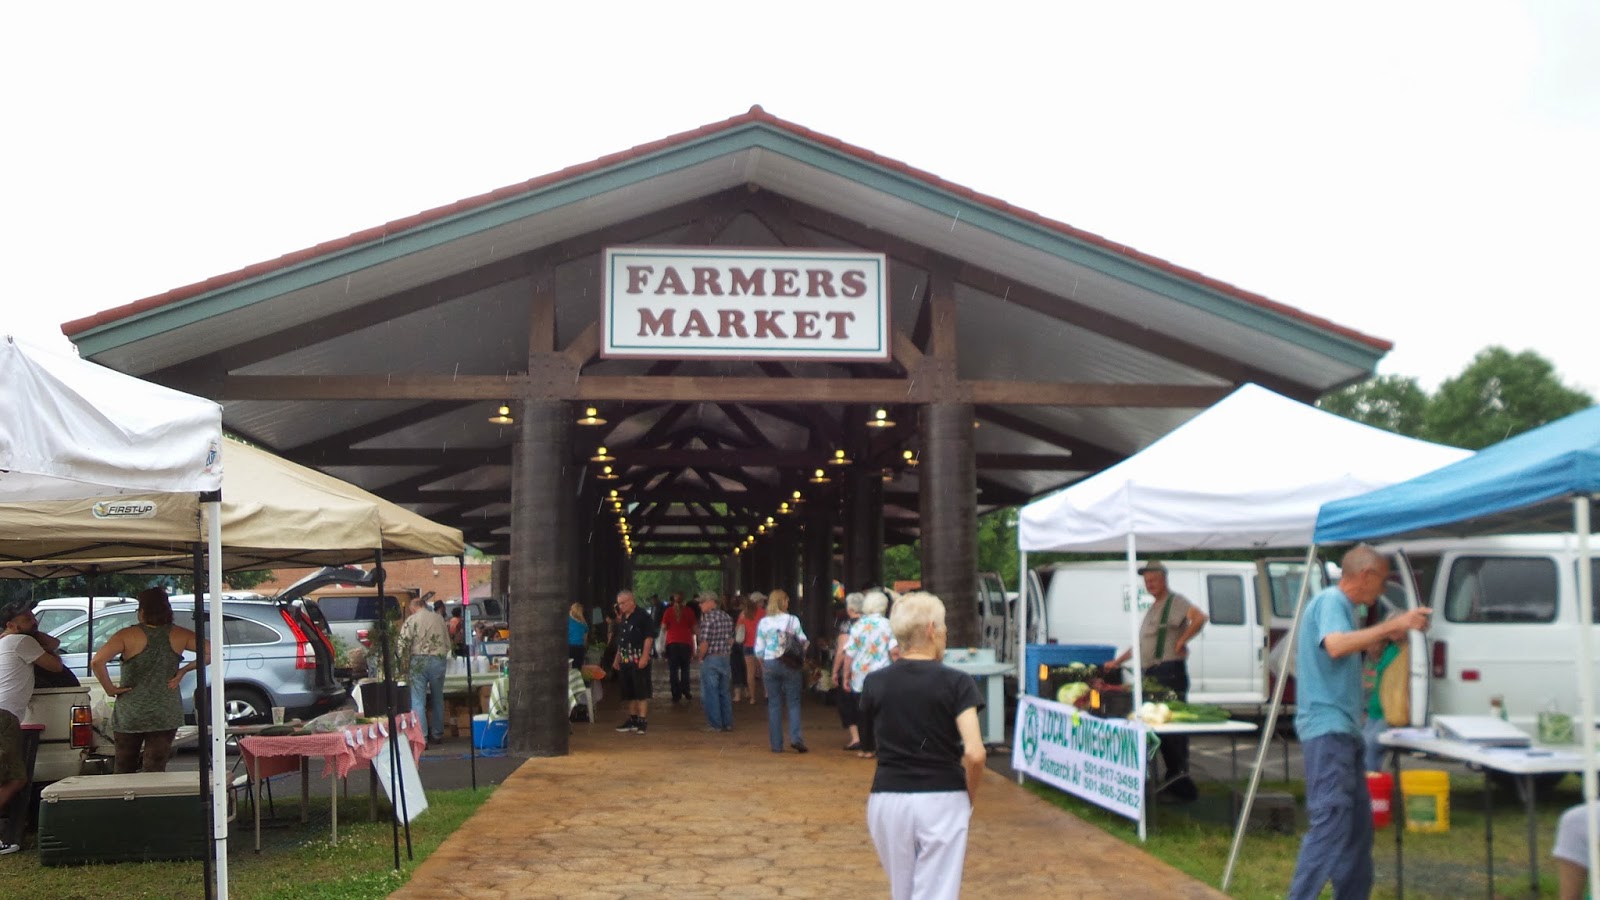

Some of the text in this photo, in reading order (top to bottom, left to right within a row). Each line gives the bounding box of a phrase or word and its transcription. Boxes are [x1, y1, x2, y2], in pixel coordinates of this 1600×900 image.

[626, 265, 867, 298] FARMERS
[637, 307, 856, 340] MARKET
[1041, 709, 1140, 770] LOCAL HOMEGROWN
[1039, 751, 1071, 780] Bismarck
[1083, 761, 1140, 791] 501-617-3498
